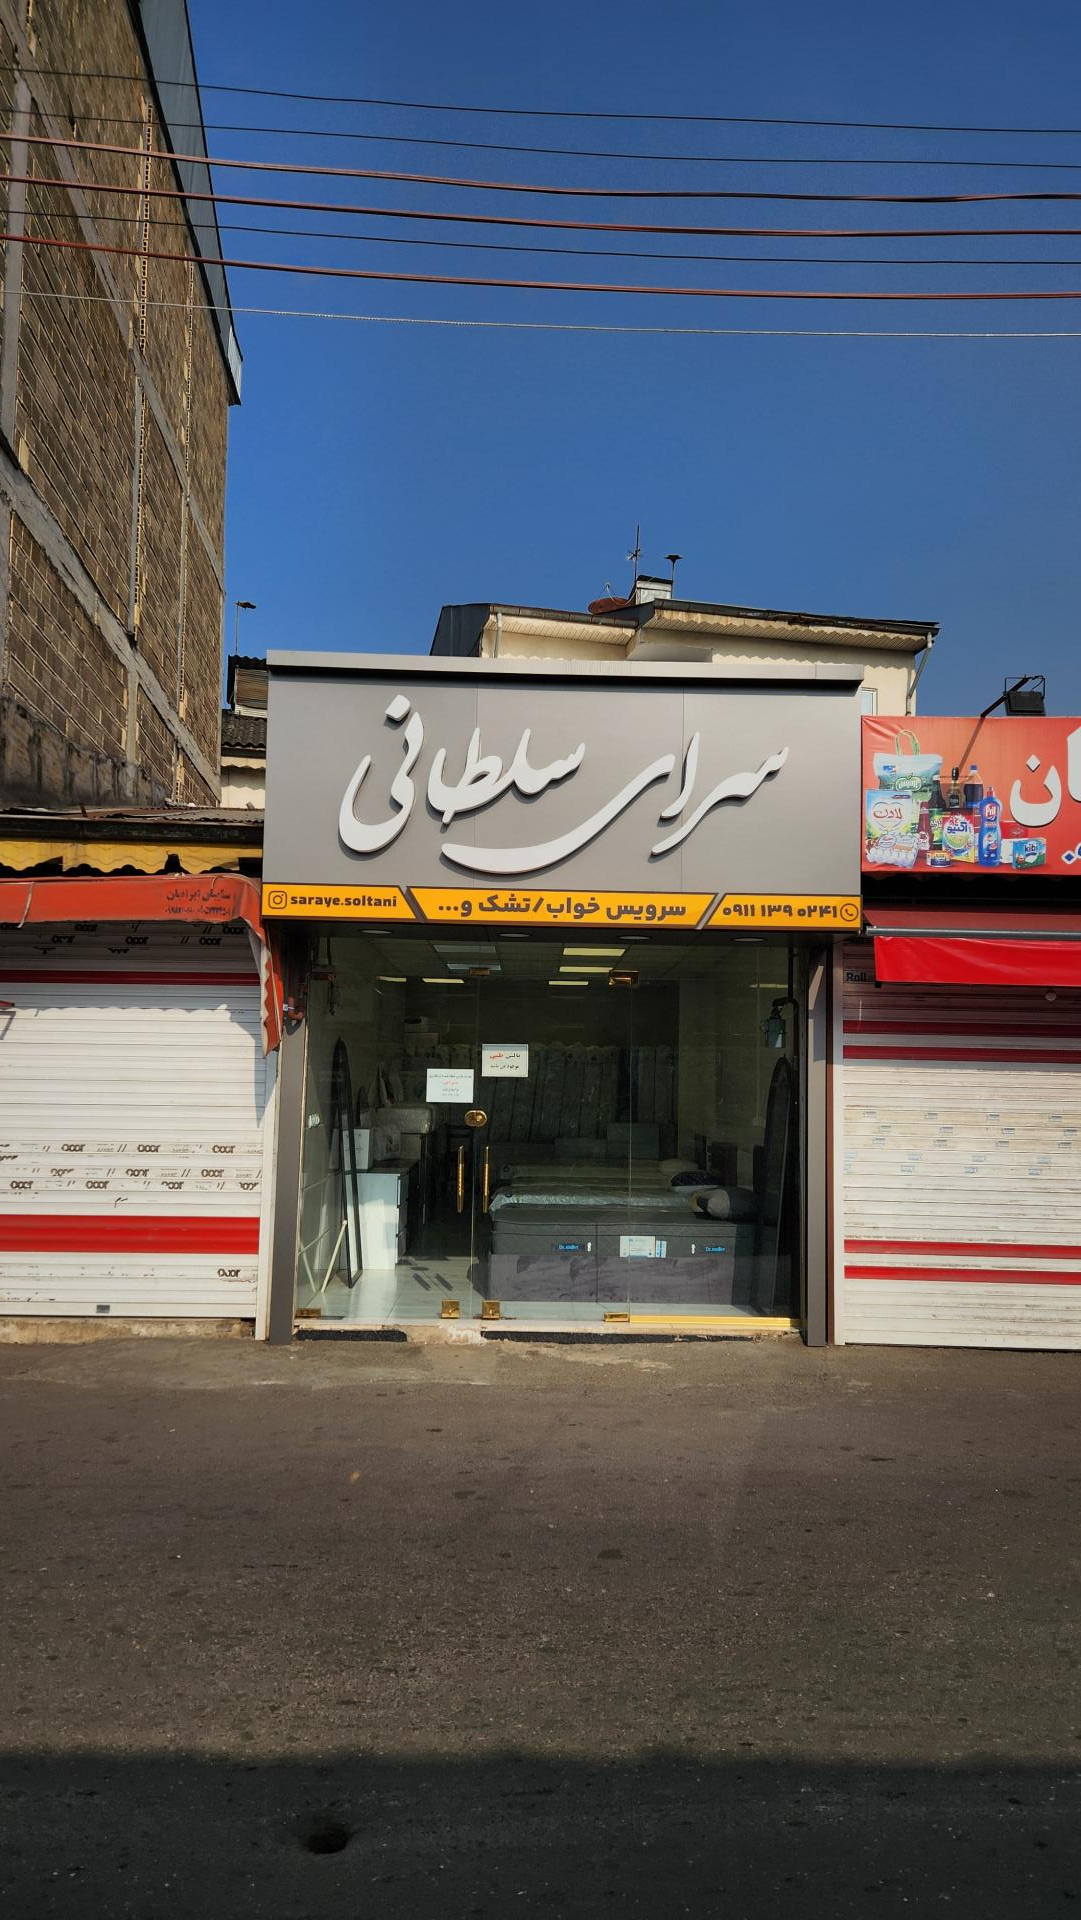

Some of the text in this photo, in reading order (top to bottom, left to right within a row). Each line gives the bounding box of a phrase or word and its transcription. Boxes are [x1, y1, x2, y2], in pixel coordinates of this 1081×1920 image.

[338, 694, 790, 874] سرای سلطانی
[985, 804, 997, 817] Pril
[290, 895, 397, 907] saraye.soltani
[606, 901, 687, 921] سرویس
[723, 904, 838, 918] ۰۹۱۱ ۱۳۹ ۰۲۴۱
[846, 972, 867, 982] Roll
